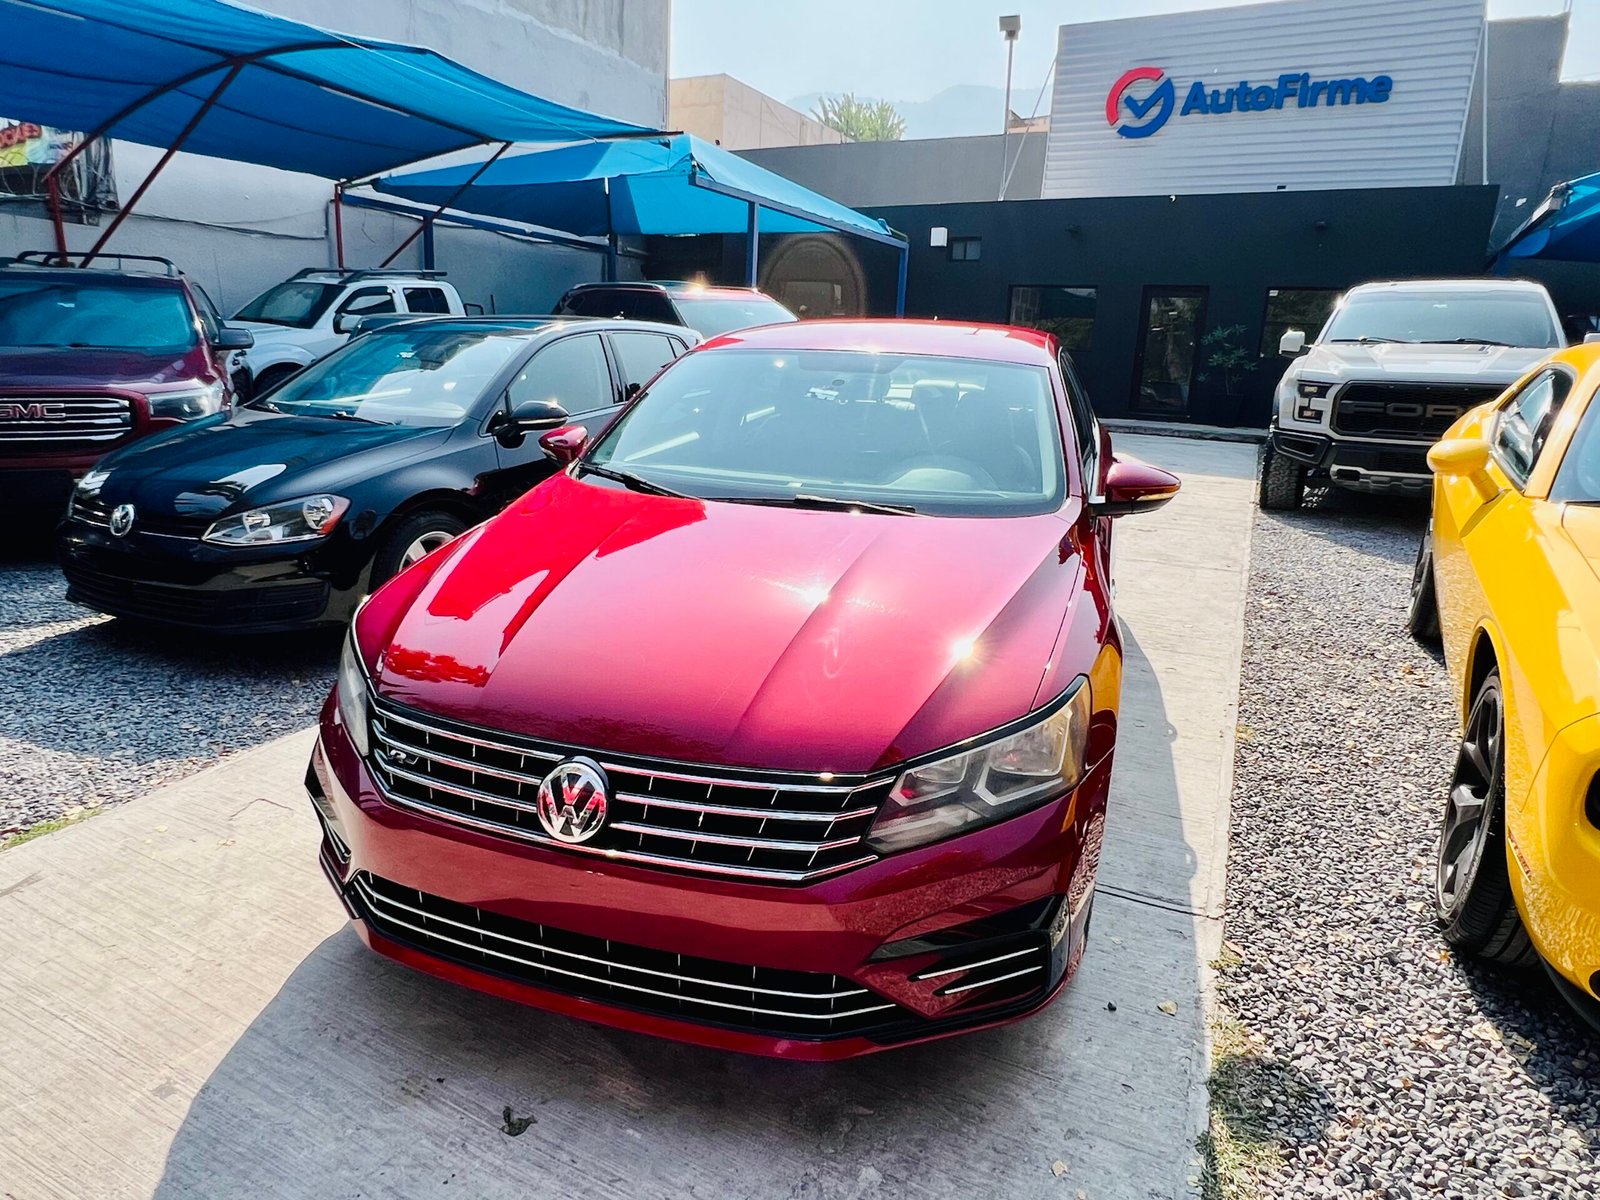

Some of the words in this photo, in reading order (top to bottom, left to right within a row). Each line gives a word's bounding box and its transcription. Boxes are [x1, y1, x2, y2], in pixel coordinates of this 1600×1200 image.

[1180, 72, 1393, 116] AutoFirme
[1338, 400, 1465, 418] FOR
[538, 762, 606, 843] VW
